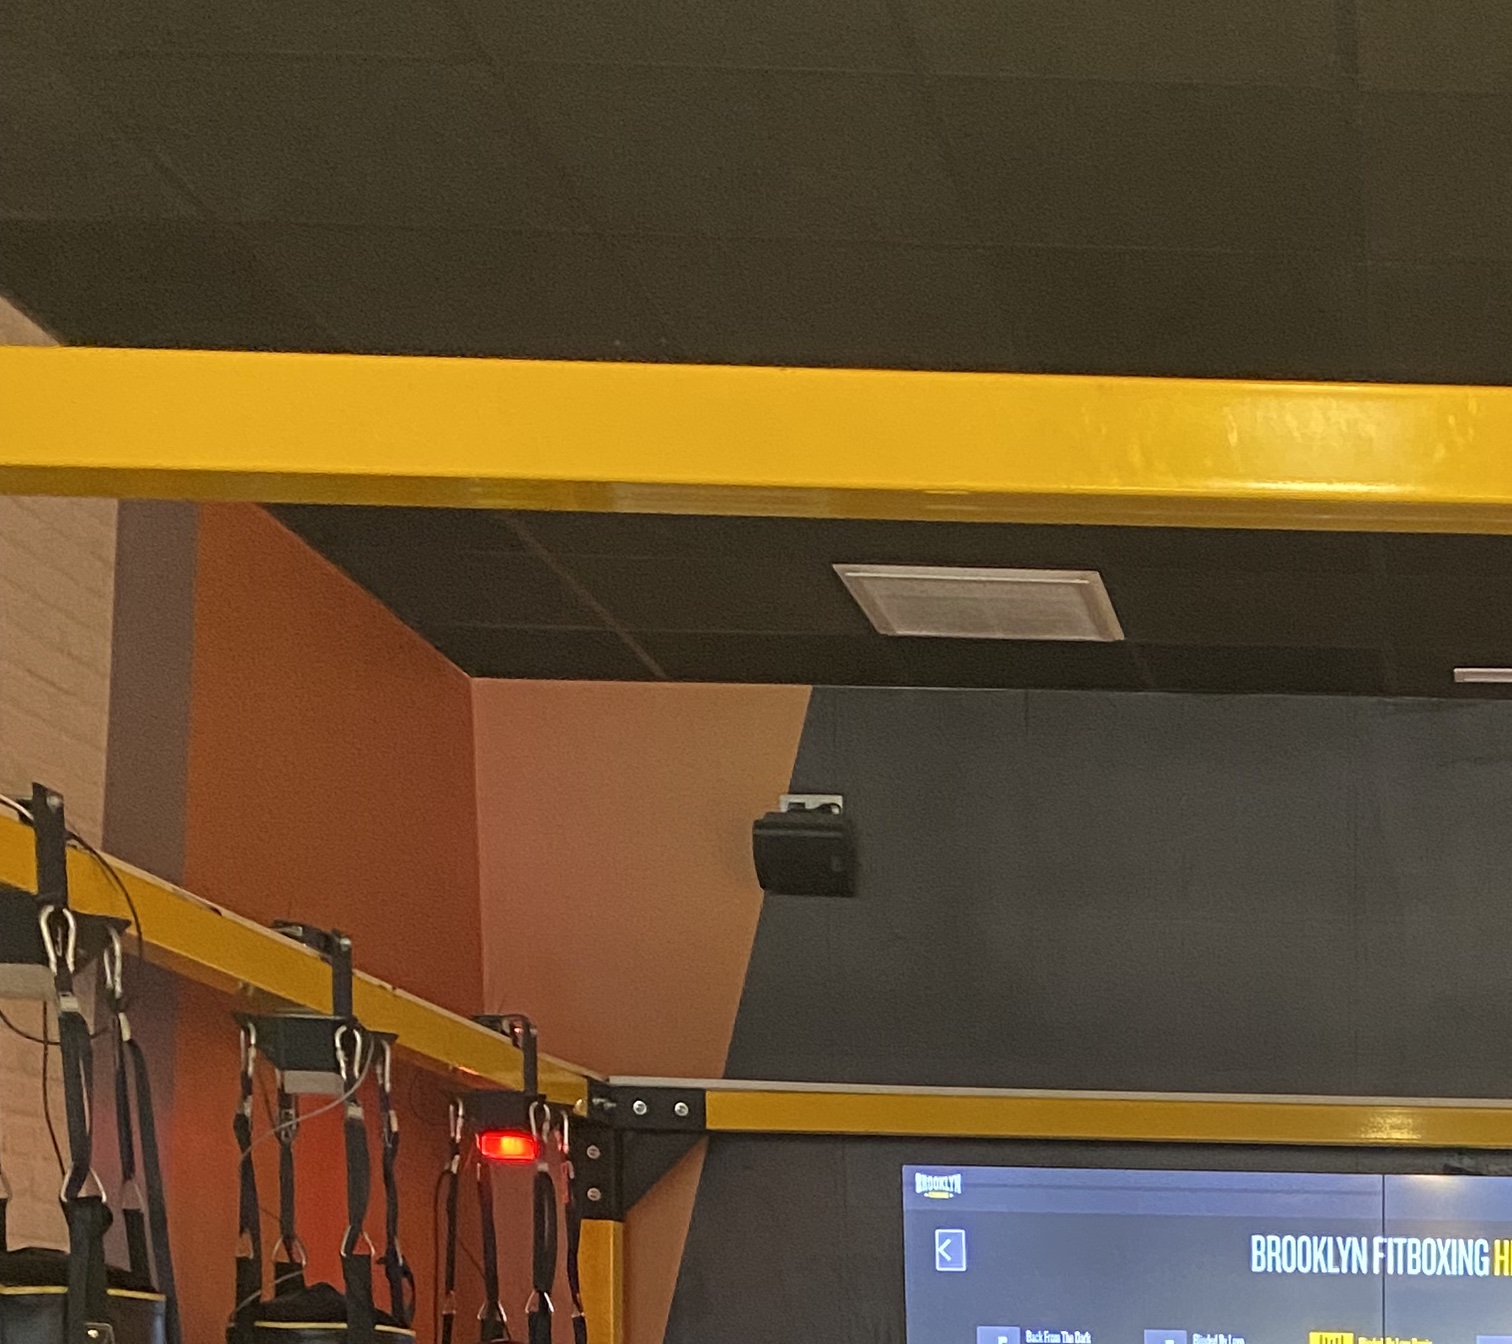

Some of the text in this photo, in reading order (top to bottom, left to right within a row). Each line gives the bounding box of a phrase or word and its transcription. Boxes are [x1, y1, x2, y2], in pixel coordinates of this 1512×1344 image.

[915, 1172, 962, 1194] BROOKLYN
[1251, 1234, 1368, 1274] BROOKLYN
[1372, 1235, 1490, 1277] FITBOXING
[1025, 1329, 1092, 1344] Back From The Dark
